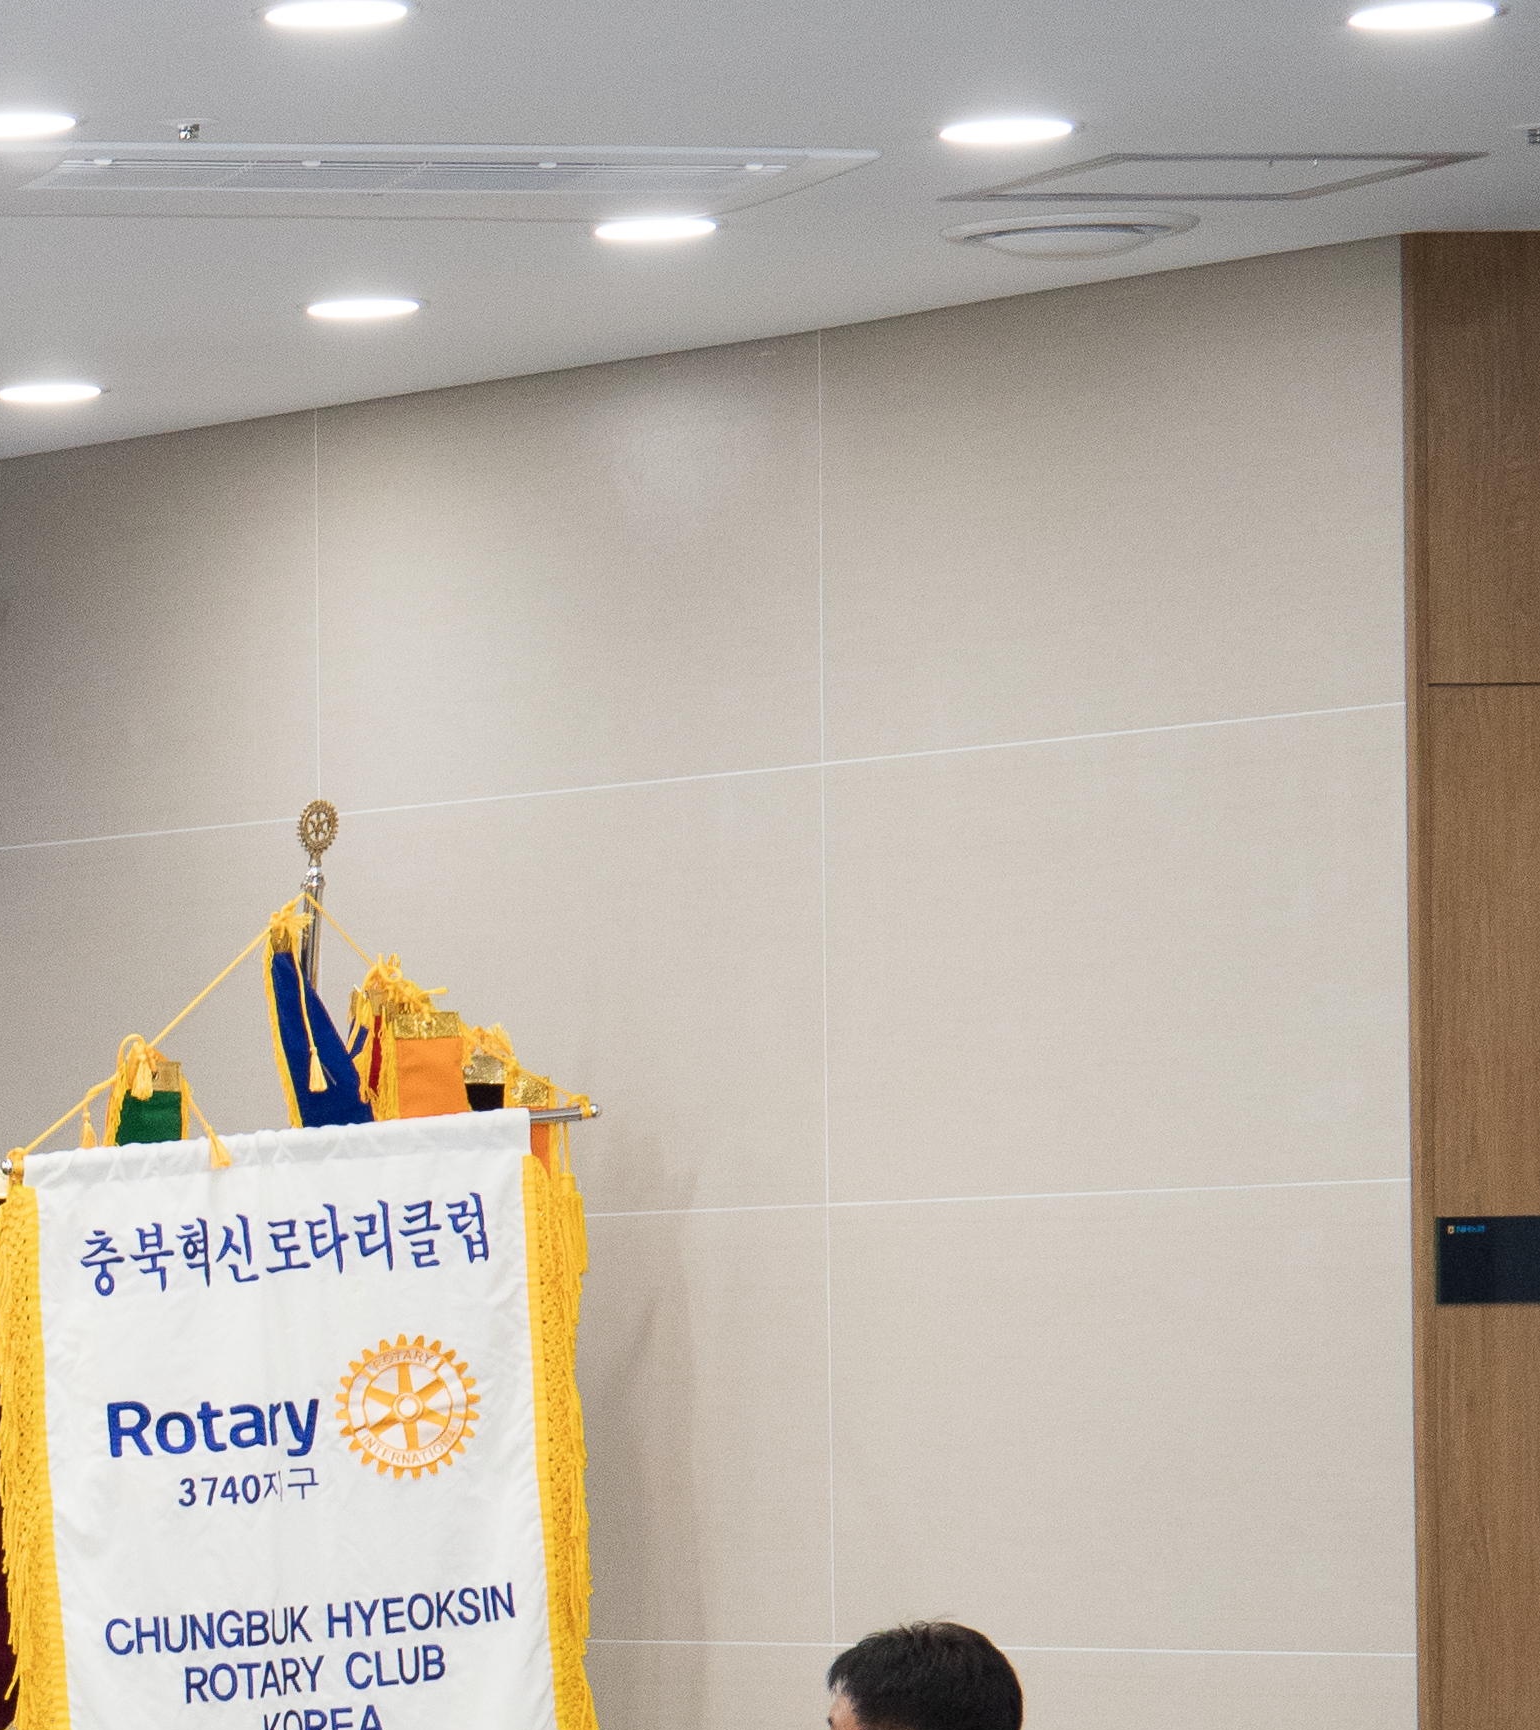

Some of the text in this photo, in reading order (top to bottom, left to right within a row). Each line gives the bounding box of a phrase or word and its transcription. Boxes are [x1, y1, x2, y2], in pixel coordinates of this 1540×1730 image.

[107, 1399, 319, 1458] Rotary
[178, 1467, 318, 1507] 3740지구
[105, 1582, 515, 1655] CHUNGBUK HYEOKSIN
[185, 1644, 446, 1704] ROTARY CLUB
